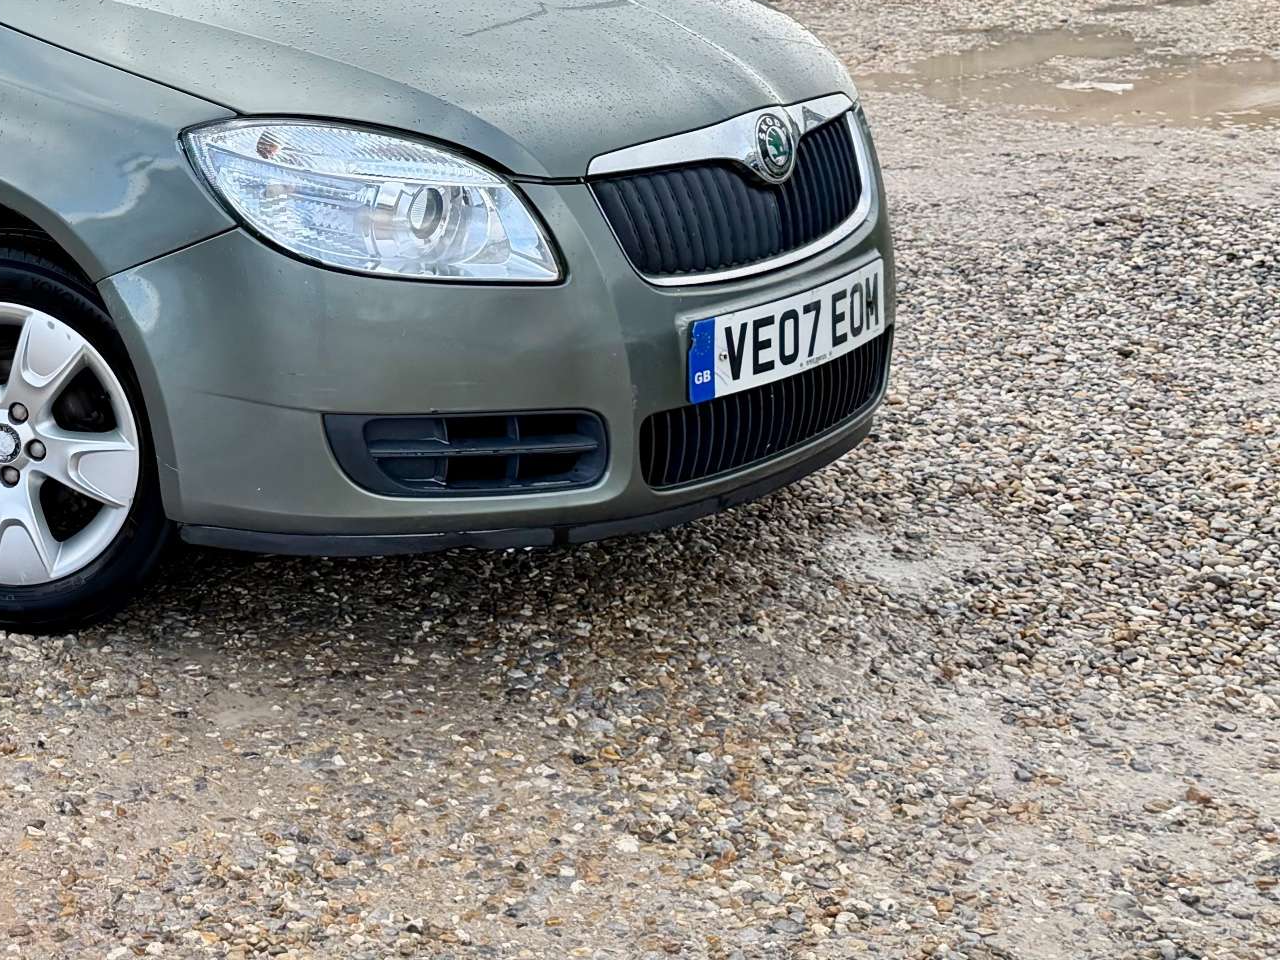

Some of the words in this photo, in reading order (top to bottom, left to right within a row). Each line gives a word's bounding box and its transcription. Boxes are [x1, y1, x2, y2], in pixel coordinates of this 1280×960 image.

[724, 299, 821, 381] VE07
[831, 272, 879, 348] EOM
[694, 369, 711, 385] GB
